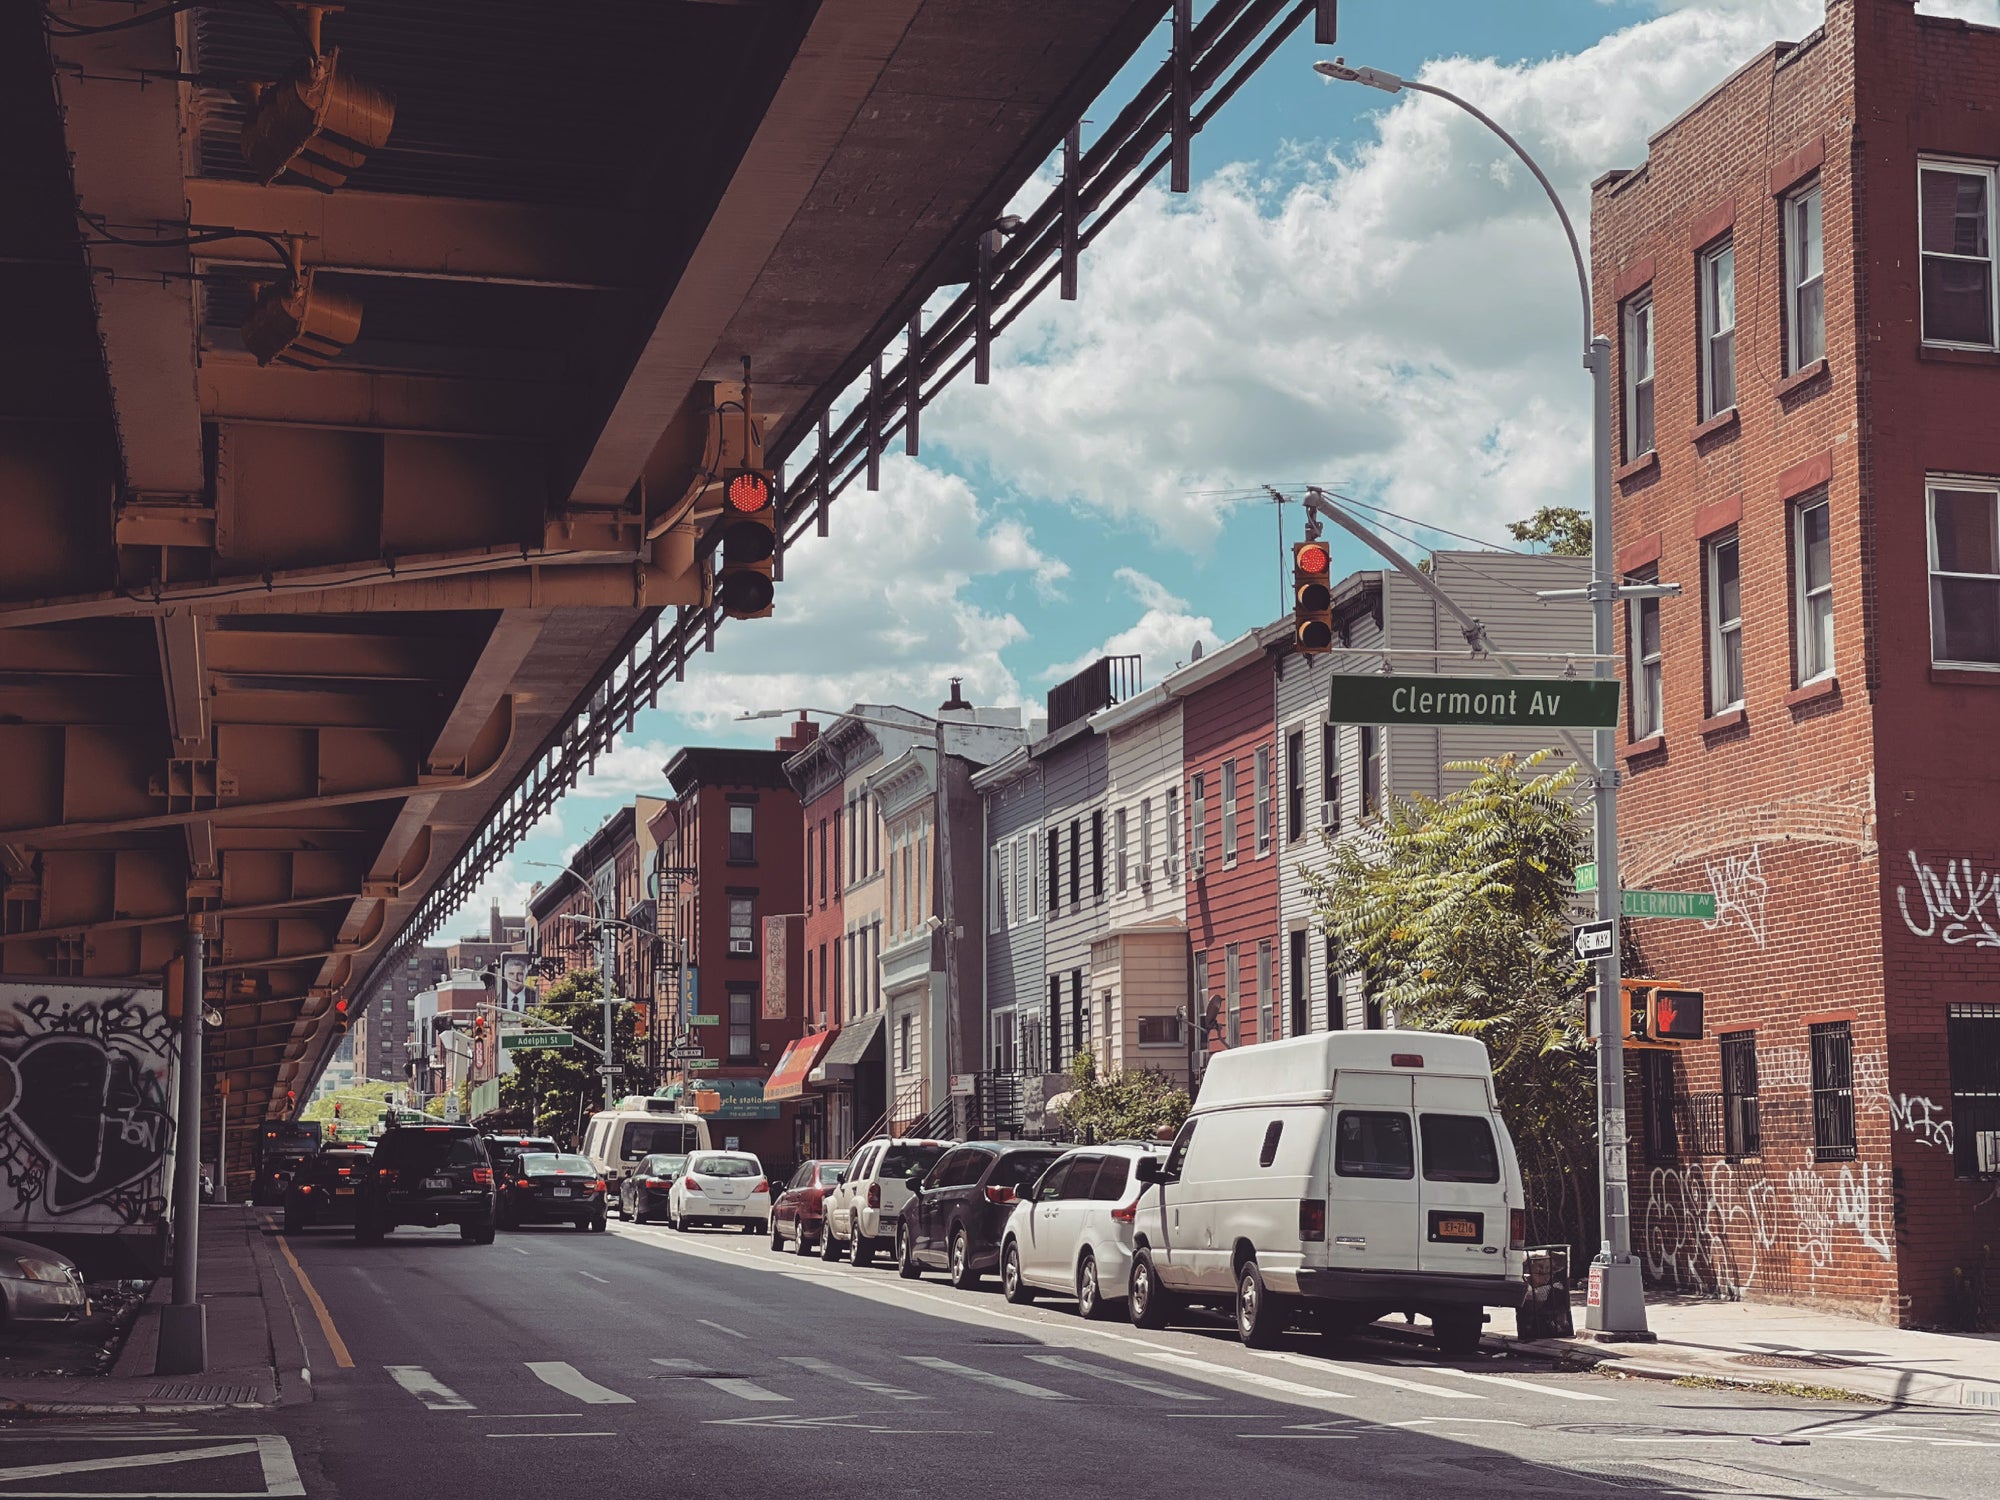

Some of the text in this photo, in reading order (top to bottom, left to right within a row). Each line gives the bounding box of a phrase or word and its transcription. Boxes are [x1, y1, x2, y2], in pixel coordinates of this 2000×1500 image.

[1392, 686, 1561, 716] Clermont Av
[1576, 866, 1594, 890] PARK
[1623, 893, 1710, 914] CLERMONT AV
[1578, 932, 1609, 950] ONE WAY
[517, 1036, 558, 1046] Adelphi St
[446, 1105, 458, 1113] 25
[720, 1095, 738, 1106] ycle
